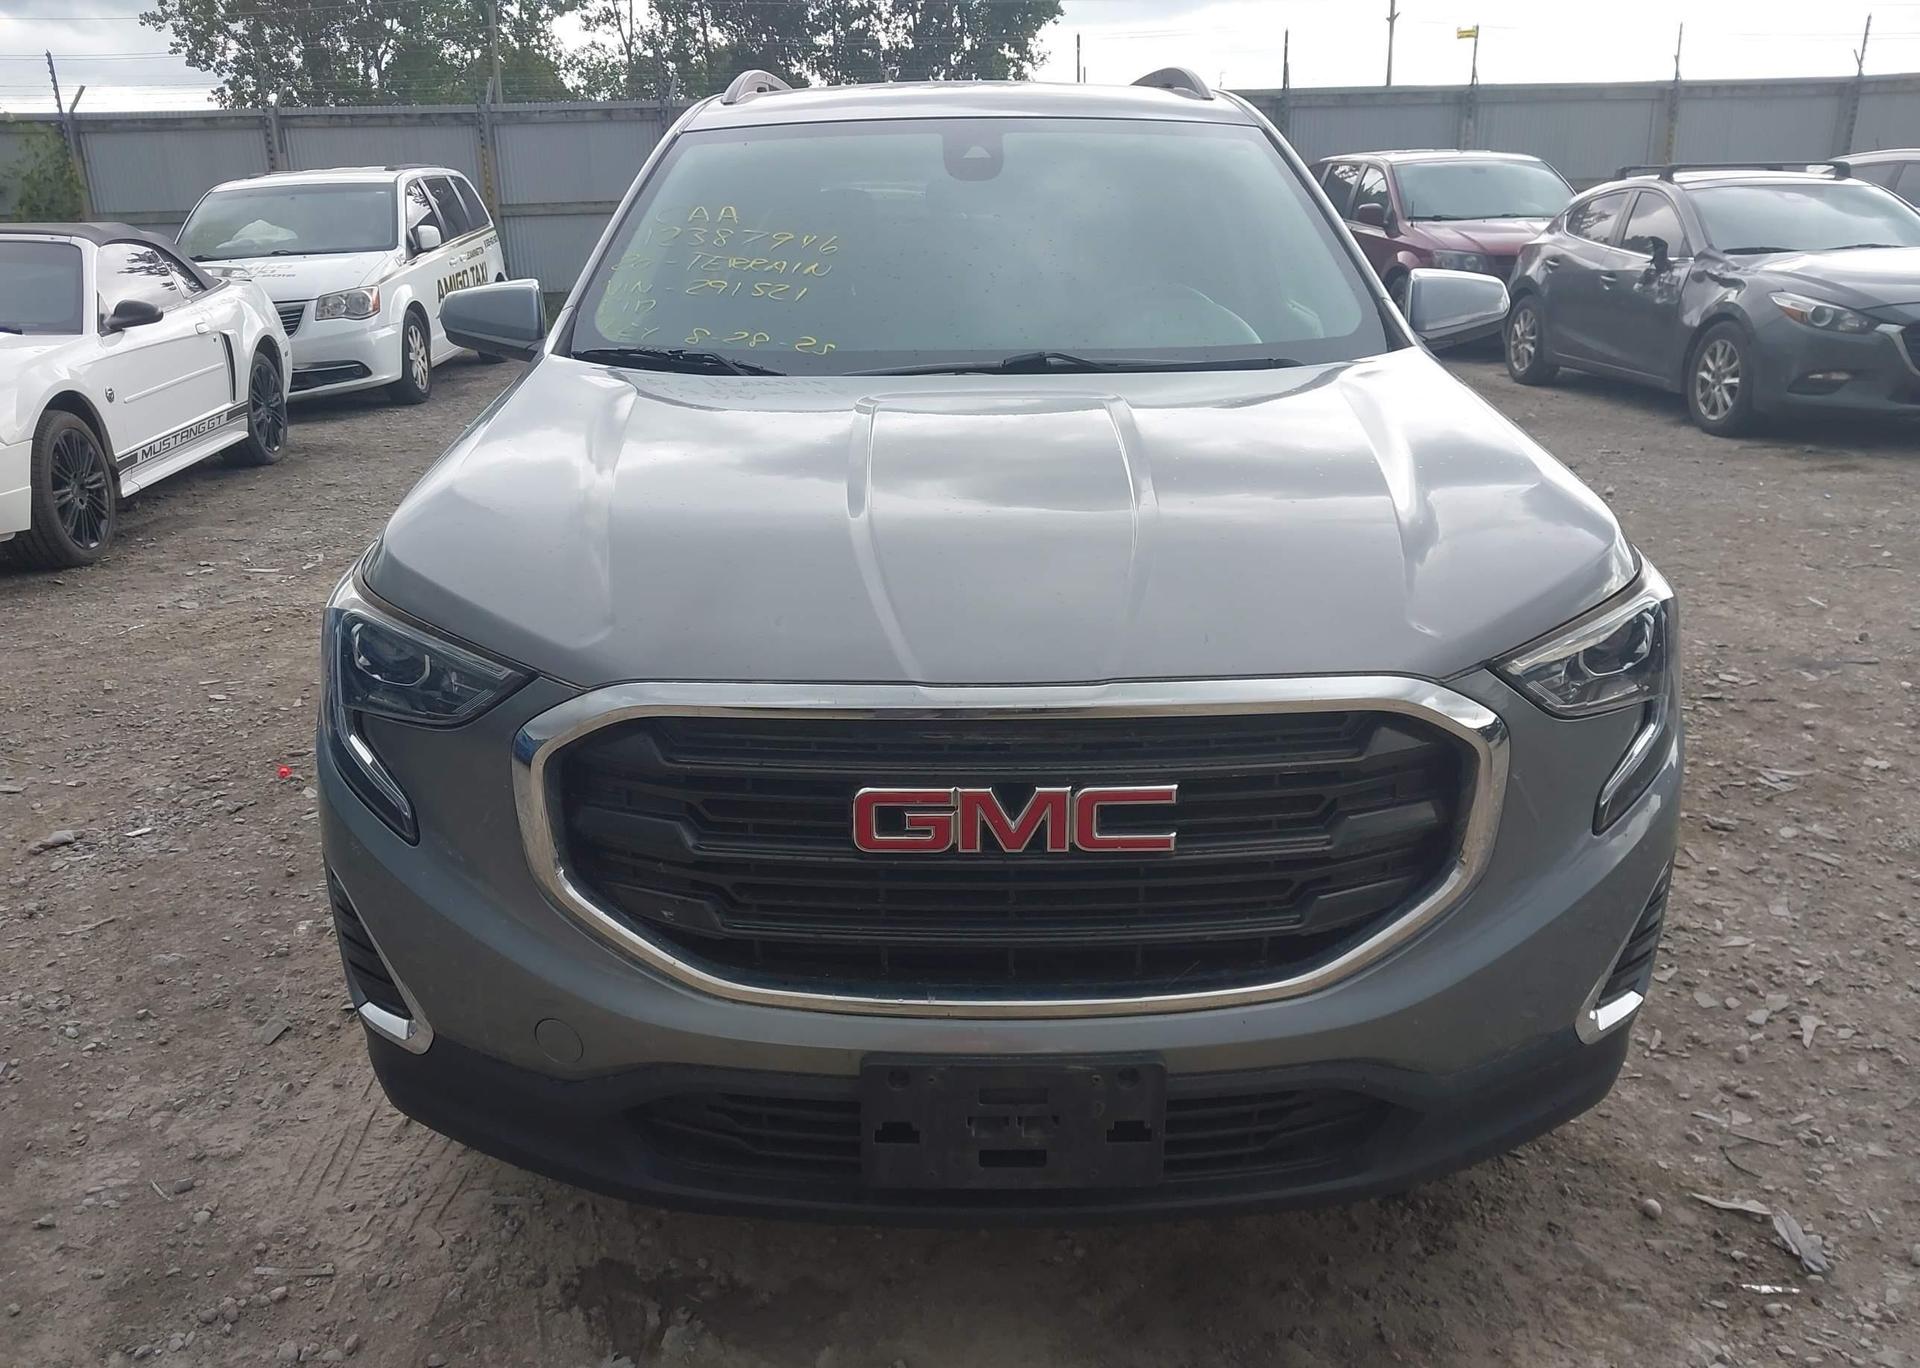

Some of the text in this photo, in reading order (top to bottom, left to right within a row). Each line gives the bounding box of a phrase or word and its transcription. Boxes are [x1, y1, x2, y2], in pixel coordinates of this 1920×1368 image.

[437, 261, 489, 303] AMIGO TAXI
[686, 251, 832, 277] TERRAIN
[685, 279, 808, 303] 291521
[141, 414, 224, 460] MUSTANG GT
[853, 785, 1179, 853] GMC
